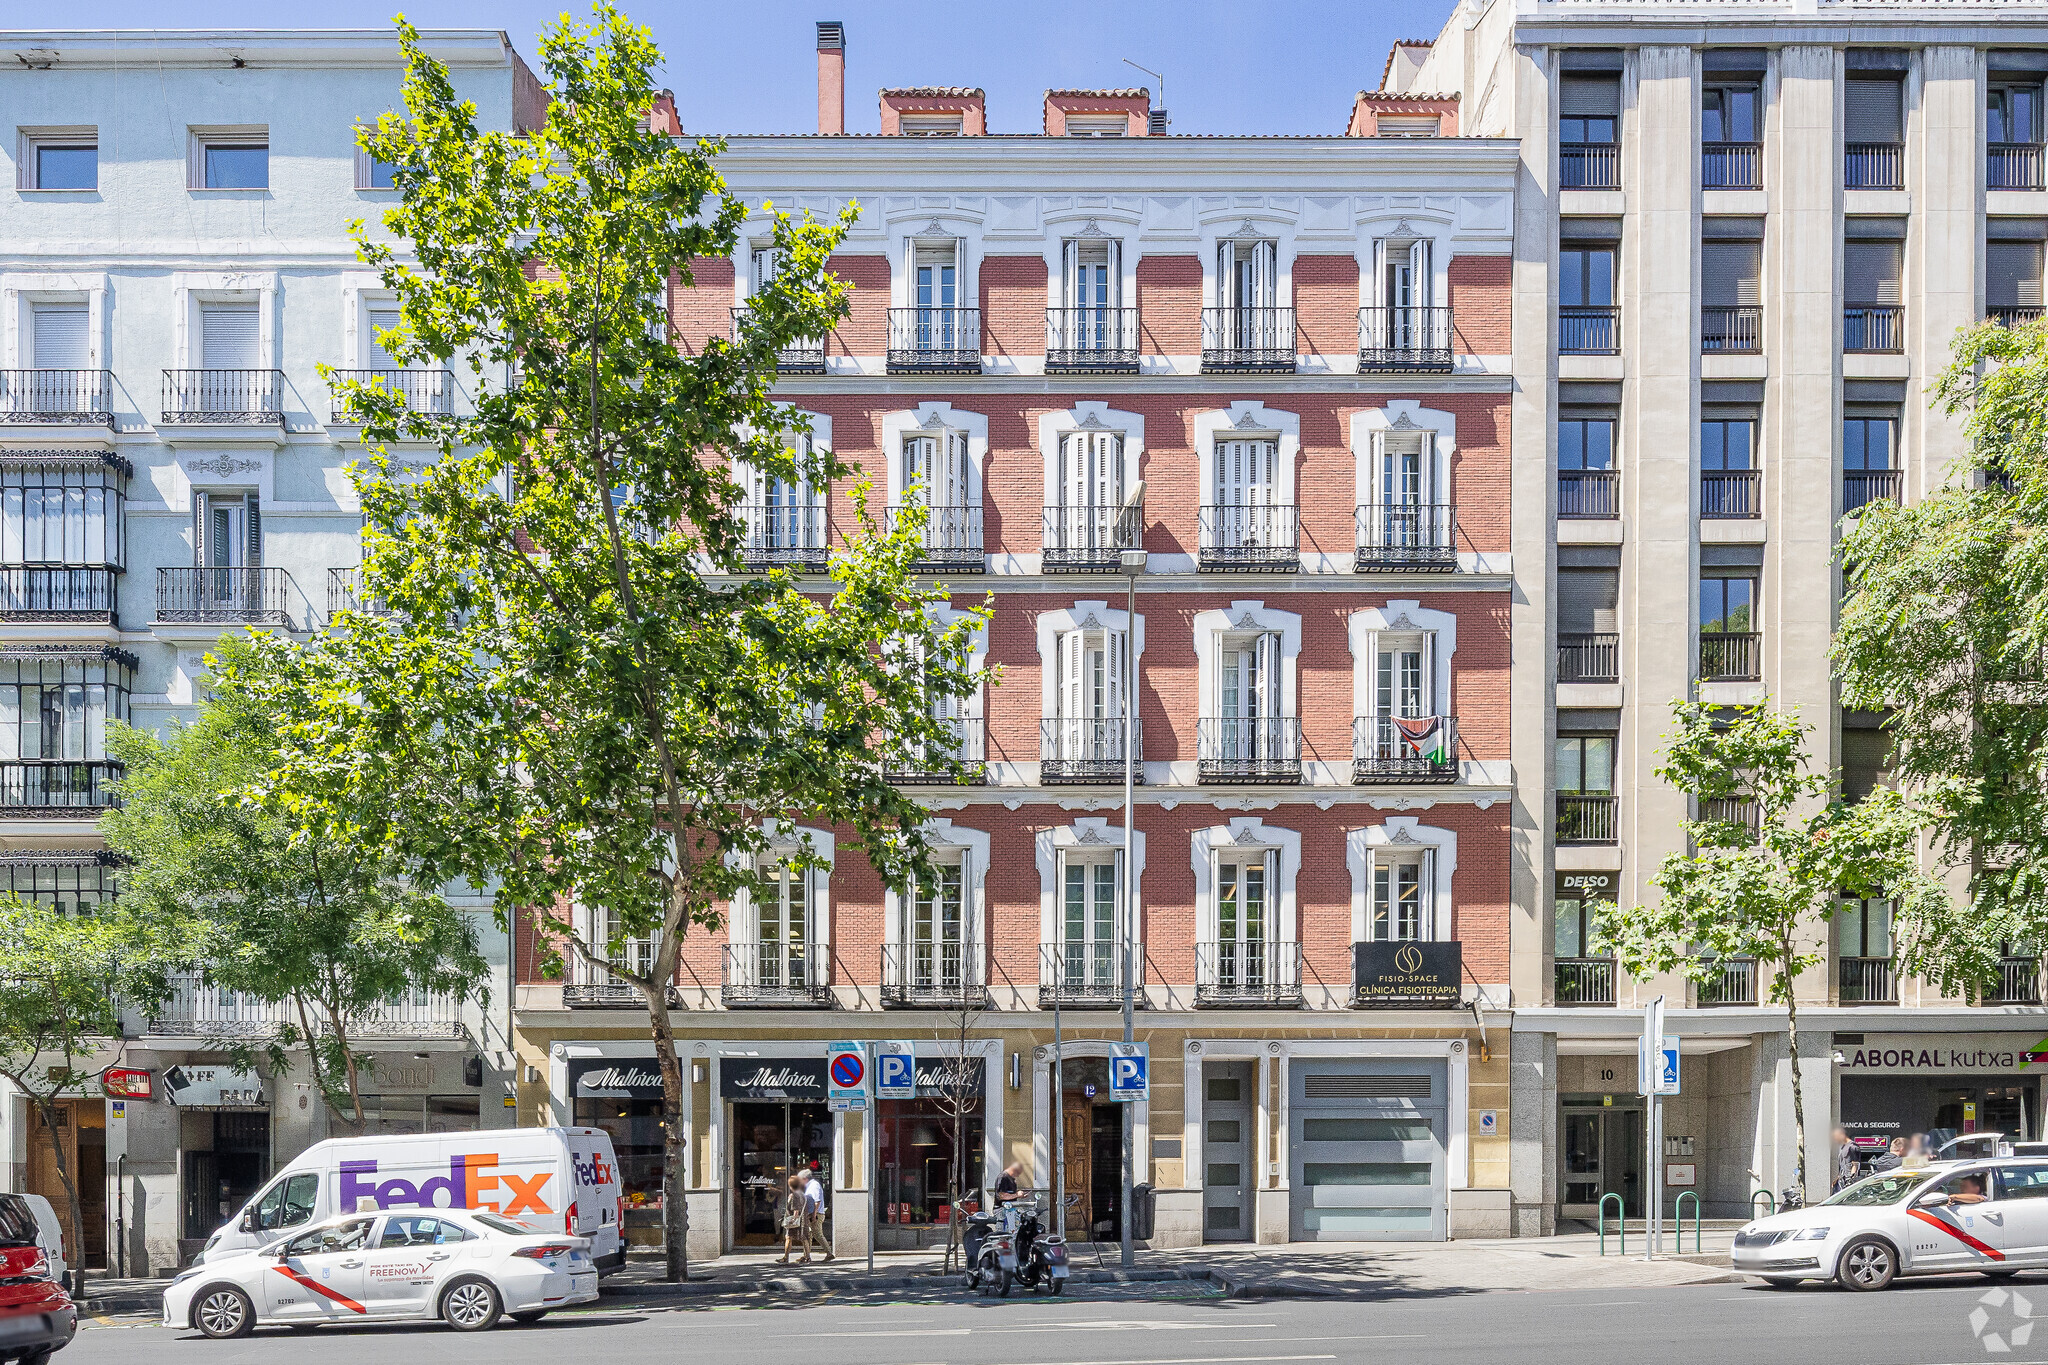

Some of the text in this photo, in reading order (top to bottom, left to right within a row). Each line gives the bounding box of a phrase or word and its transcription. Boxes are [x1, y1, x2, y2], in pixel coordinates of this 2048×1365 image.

[1359, 984, 1458, 995] CLÍNICA FISIOTERAPIA
[1950, 1051, 2014, 1068] kutxa
[187, 1070, 215, 1082] AFE
[734, 1067, 821, 1088] Mallorca
[883, 1057, 905, 1085] P
[1116, 1059, 1138, 1087] P
[1601, 1069, 1614, 1081] 10
[1085, 1085, 1095, 1095] 12
[1870, 1121, 1900, 1129] SEGUROS
[572, 1152, 614, 1187] FedEx
[339, 1153, 555, 1215] FedEx
[370, 1267, 418, 1277] FREENOW
